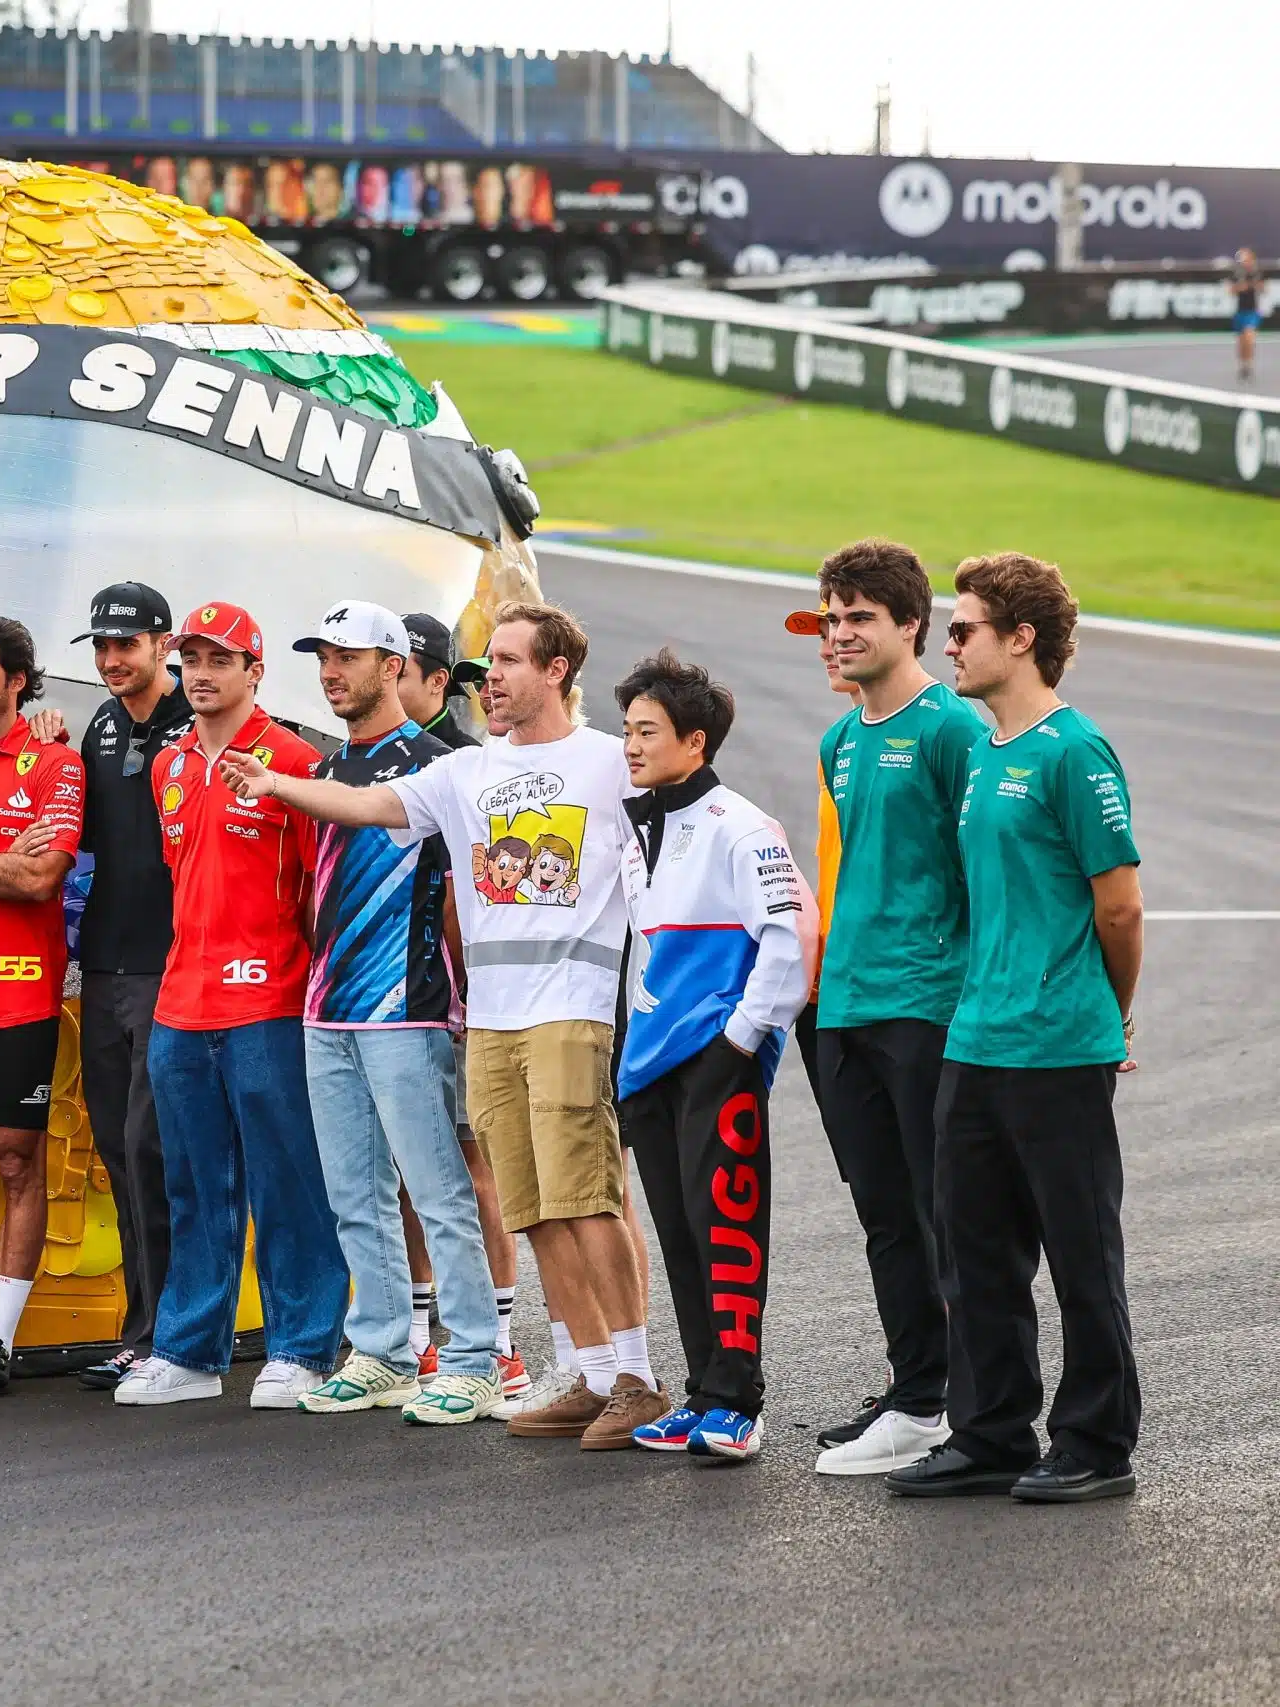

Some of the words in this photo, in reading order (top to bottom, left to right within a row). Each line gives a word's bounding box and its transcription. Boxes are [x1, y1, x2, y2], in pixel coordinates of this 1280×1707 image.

[69, 342, 422, 509] SENNA
[118, 606, 137, 616] BRB
[880, 753, 913, 763] aramco
[62, 764, 81, 775] aws
[308, 762, 322, 773] aw
[496, 781, 521, 796] KEEP
[524, 774, 546, 789] THE
[998, 781, 1028, 794] aramco
[485, 792, 522, 811] LEGACY
[526, 783, 558, 800] ALIVE!
[225, 803, 266, 820] Santander
[166, 823, 184, 838] GW
[752, 846, 789, 861] VISA
[757, 863, 794, 876] PIRELLI
[0, 956, 43, 981] 55
[222, 959, 268, 984] 16
[710, 1091, 763, 1356] HUGO
